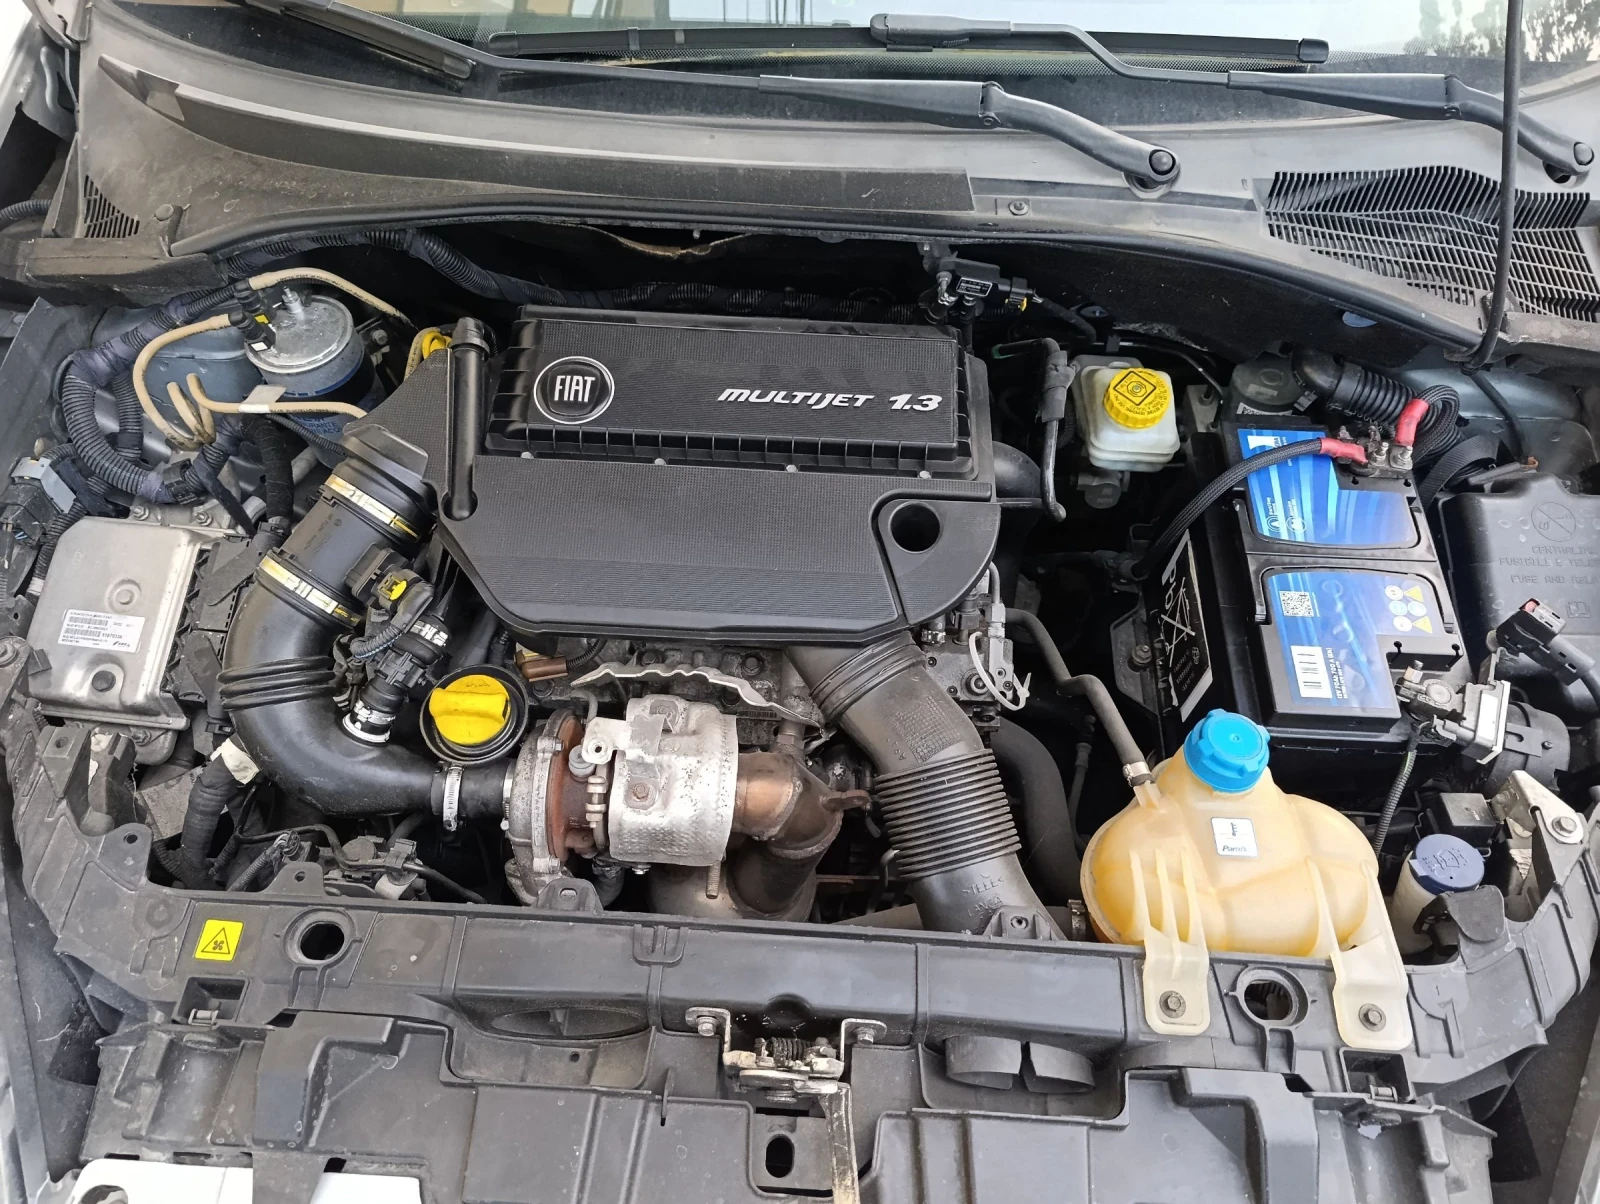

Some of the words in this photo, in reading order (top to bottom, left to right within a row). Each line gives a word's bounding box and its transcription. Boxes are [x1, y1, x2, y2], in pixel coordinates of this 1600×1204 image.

[554, 375, 596, 403] FIAT
[717, 388, 875, 410] MULTIJET
[889, 393, 943, 412] 1.3
[1510, 574, 1539, 584] FUSE
[1544, 575, 1565, 584] AND
